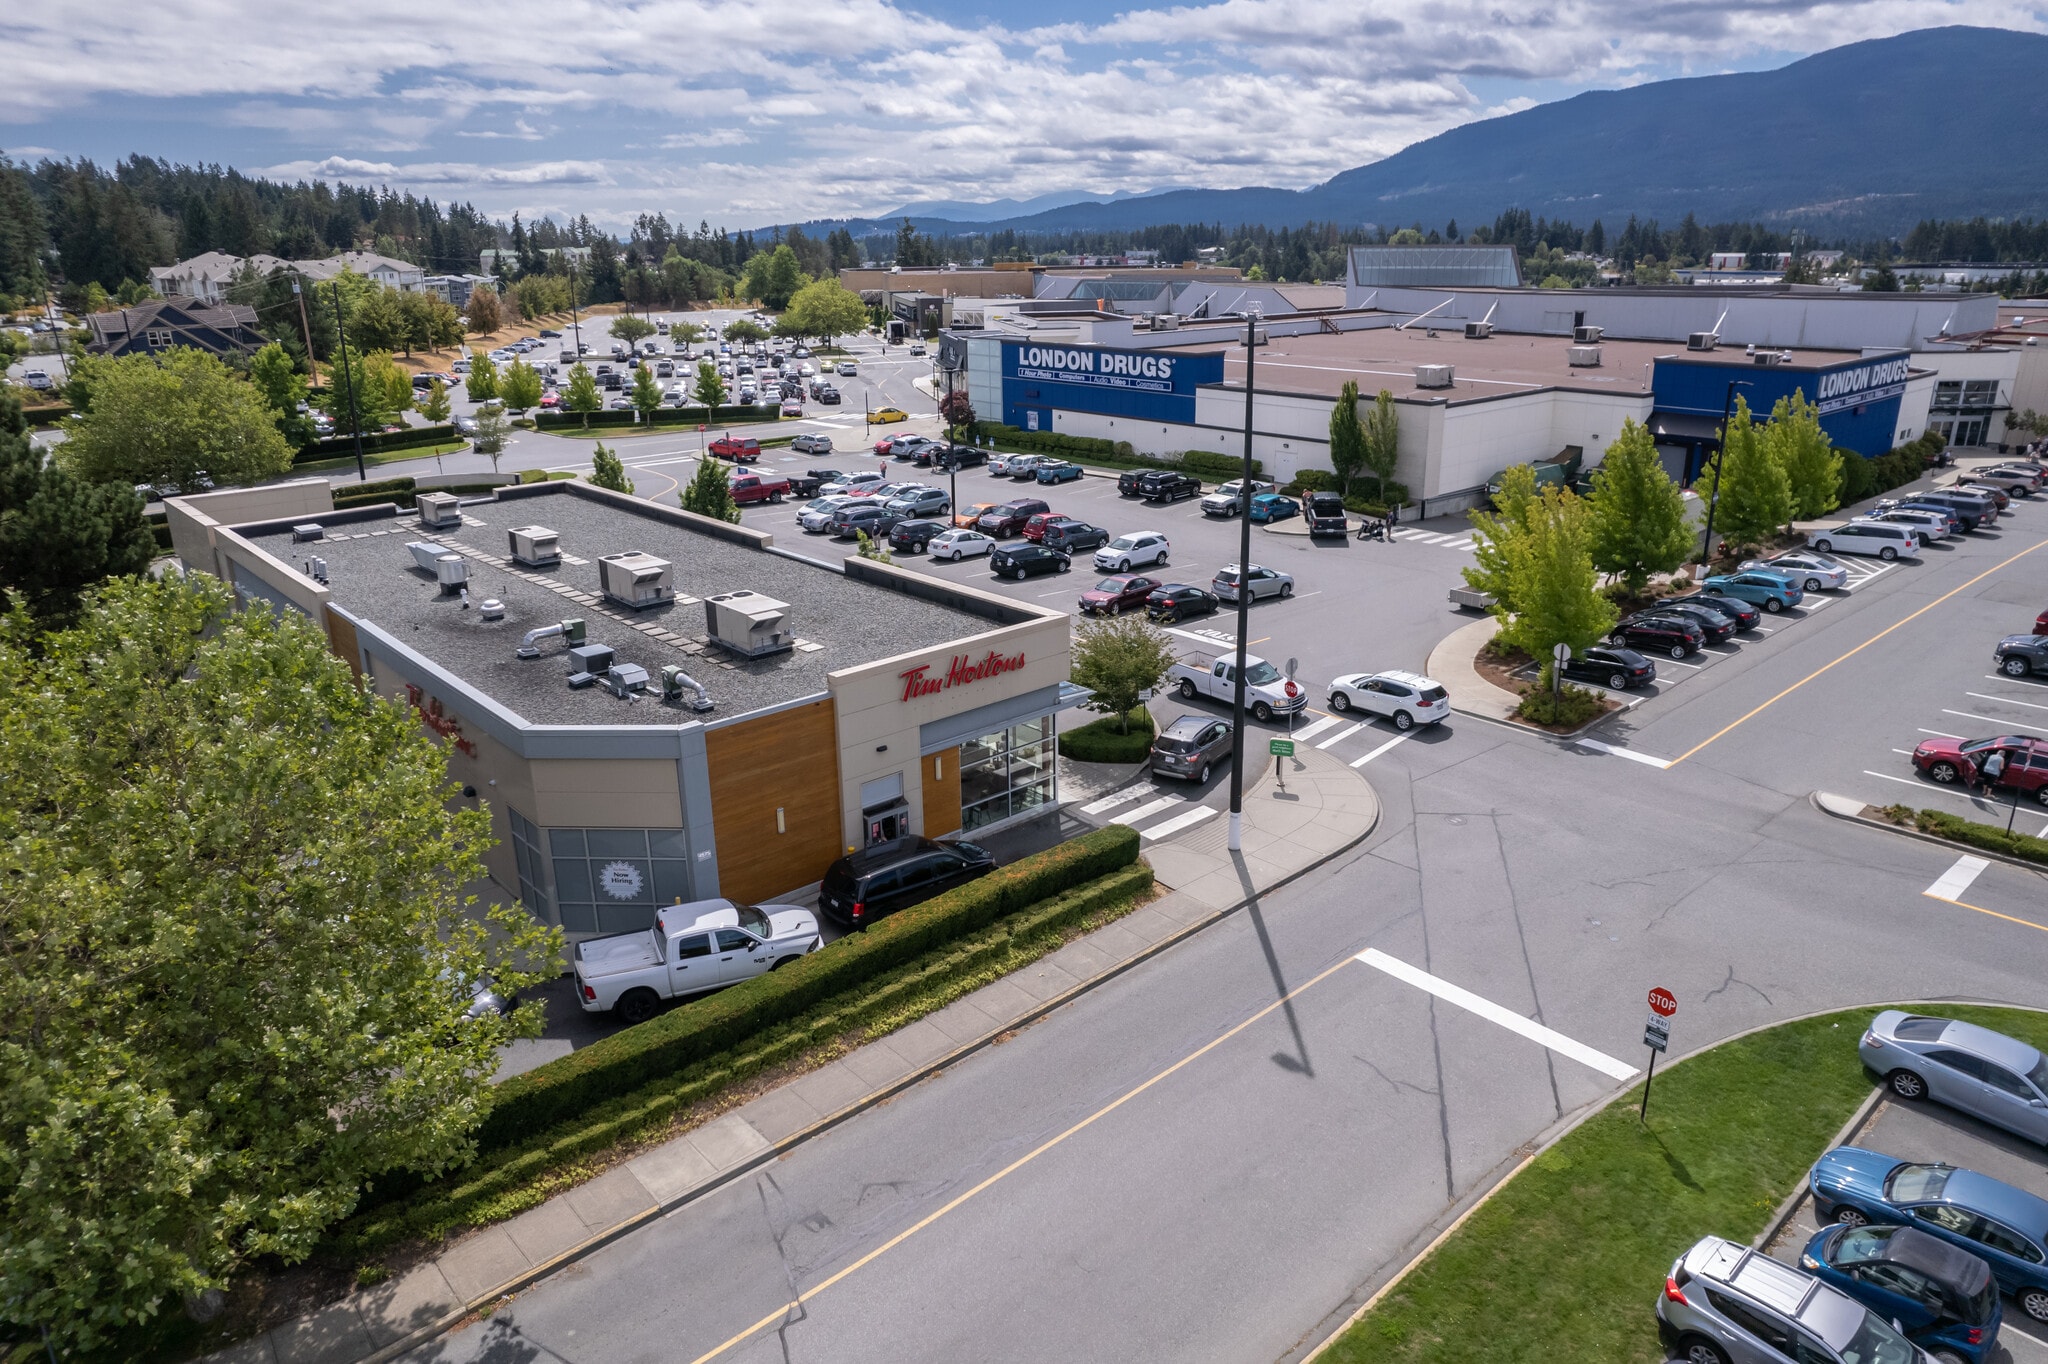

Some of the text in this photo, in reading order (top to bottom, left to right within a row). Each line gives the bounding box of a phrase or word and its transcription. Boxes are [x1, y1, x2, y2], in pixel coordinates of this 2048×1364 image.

[1019, 347, 1172, 379] LONDON DRUGS
[1037, 371, 1052, 379] Photo
[1059, 373, 1085, 382] Computers
[1093, 376, 1109, 384] Audio
[1110, 377, 1127, 386] Video
[1135, 380, 1164, 390] Cosmetics
[1819, 358, 1909, 398] LONDON DRUGS
[900, 651, 1025, 702] Tim Hortons
[1285, 684, 1297, 695] STOP
[611, 877, 633, 885] Hiring
[1649, 992, 1676, 1011] STOP
[1650, 1016, 1668, 1027] 4-WAY
